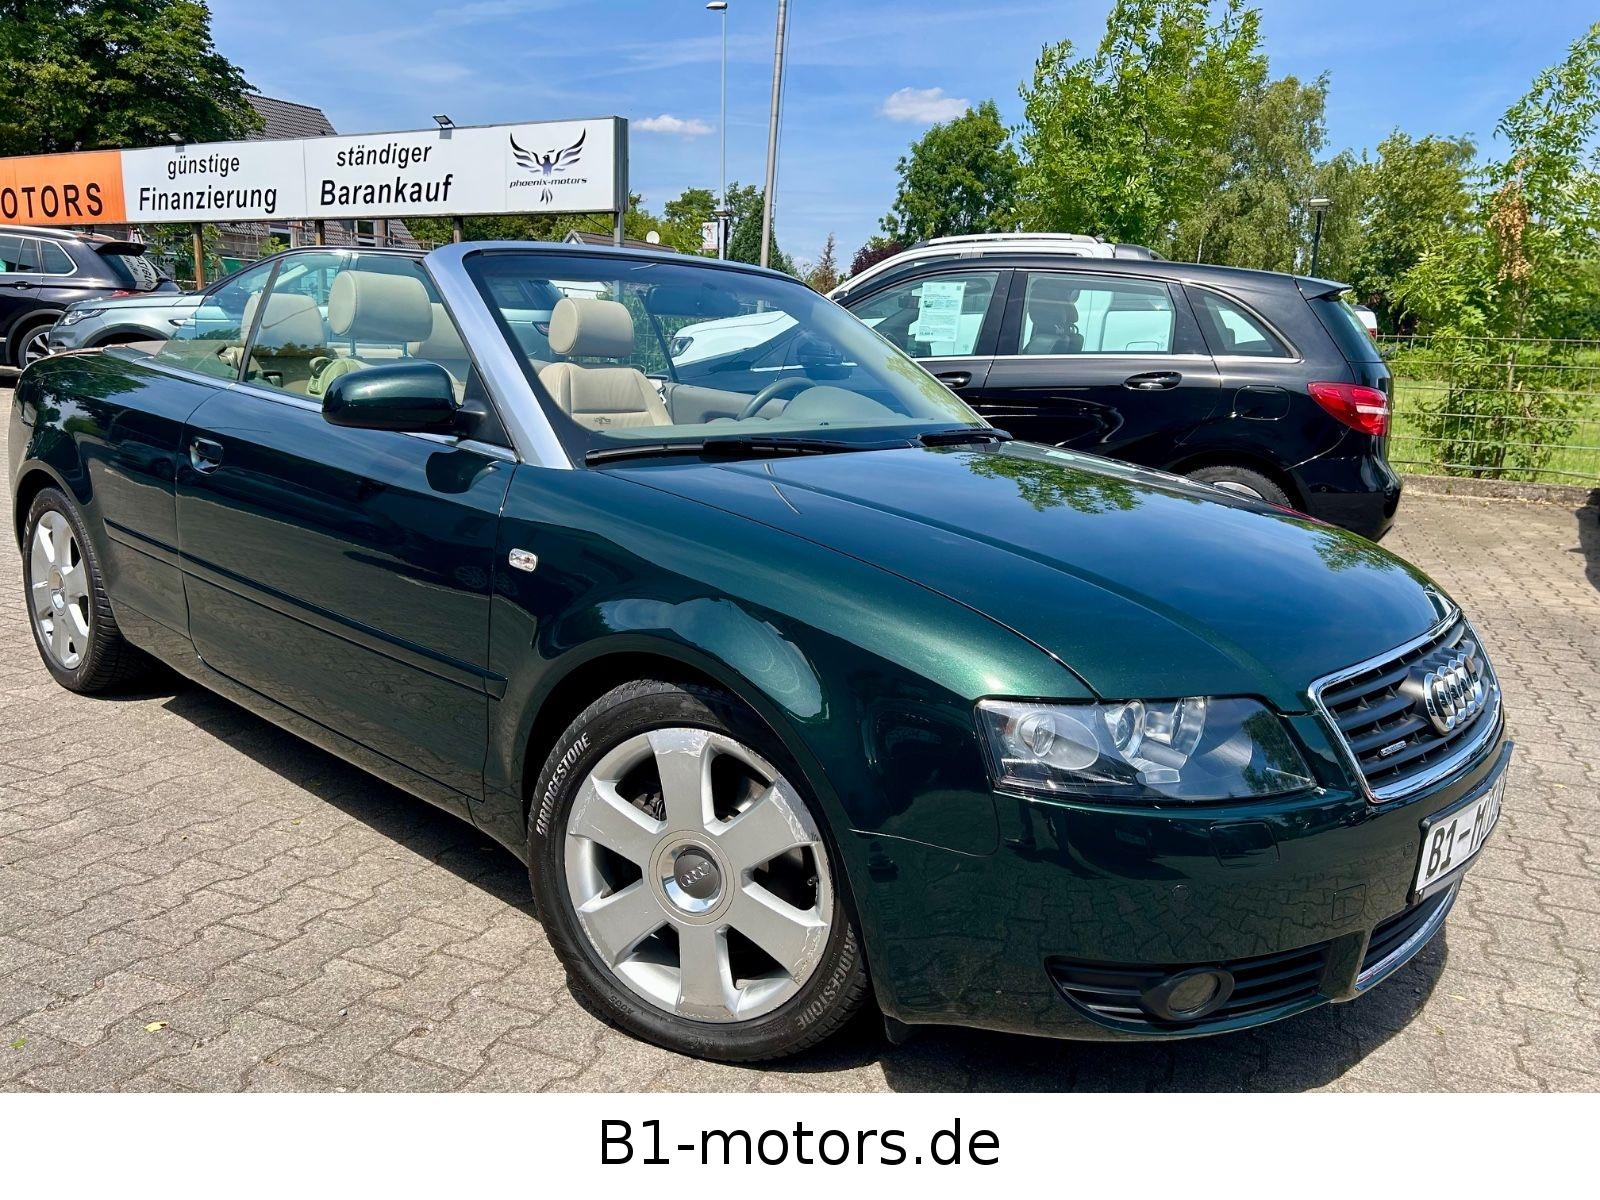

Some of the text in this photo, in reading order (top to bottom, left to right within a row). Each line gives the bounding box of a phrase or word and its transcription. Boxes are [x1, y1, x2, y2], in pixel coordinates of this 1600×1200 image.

[167, 154, 240, 180] günstige
[336, 143, 432, 168] ständiger
[320, 174, 453, 206] Barankauf
[509, 176, 588, 189] phoenix-motors
[138, 185, 278, 214] Finanzierung
[536, 732, 591, 835] BRIDGESTONE
